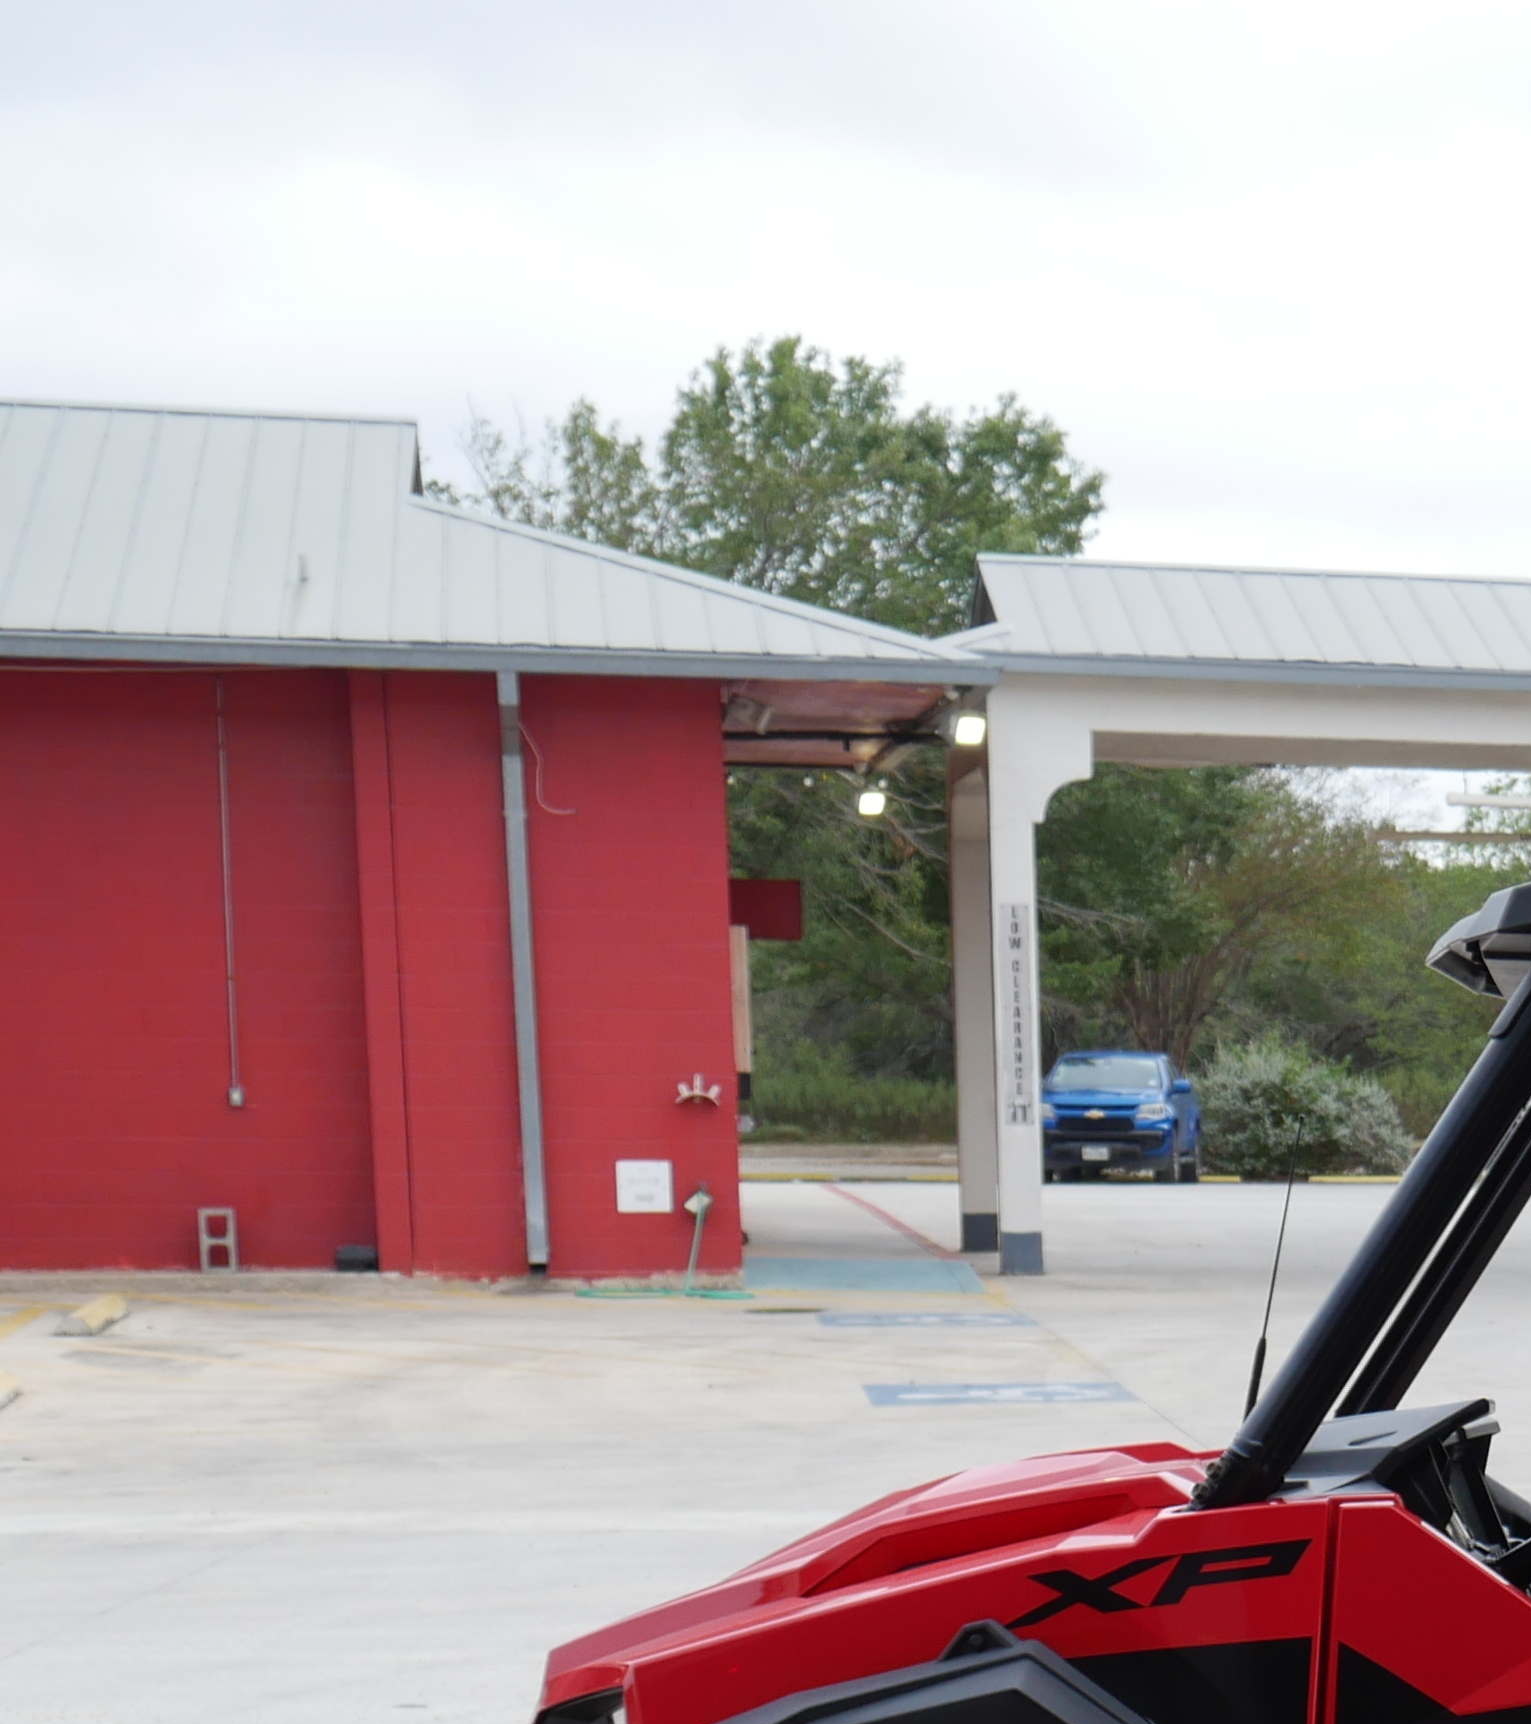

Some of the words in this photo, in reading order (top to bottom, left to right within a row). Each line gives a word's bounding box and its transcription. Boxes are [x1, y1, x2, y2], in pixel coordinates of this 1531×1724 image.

[1009, 905, 1021, 950] LOW
[1011, 960, 1023, 1096] CLEARANCE
[1001, 1538, 1313, 1630] XP
